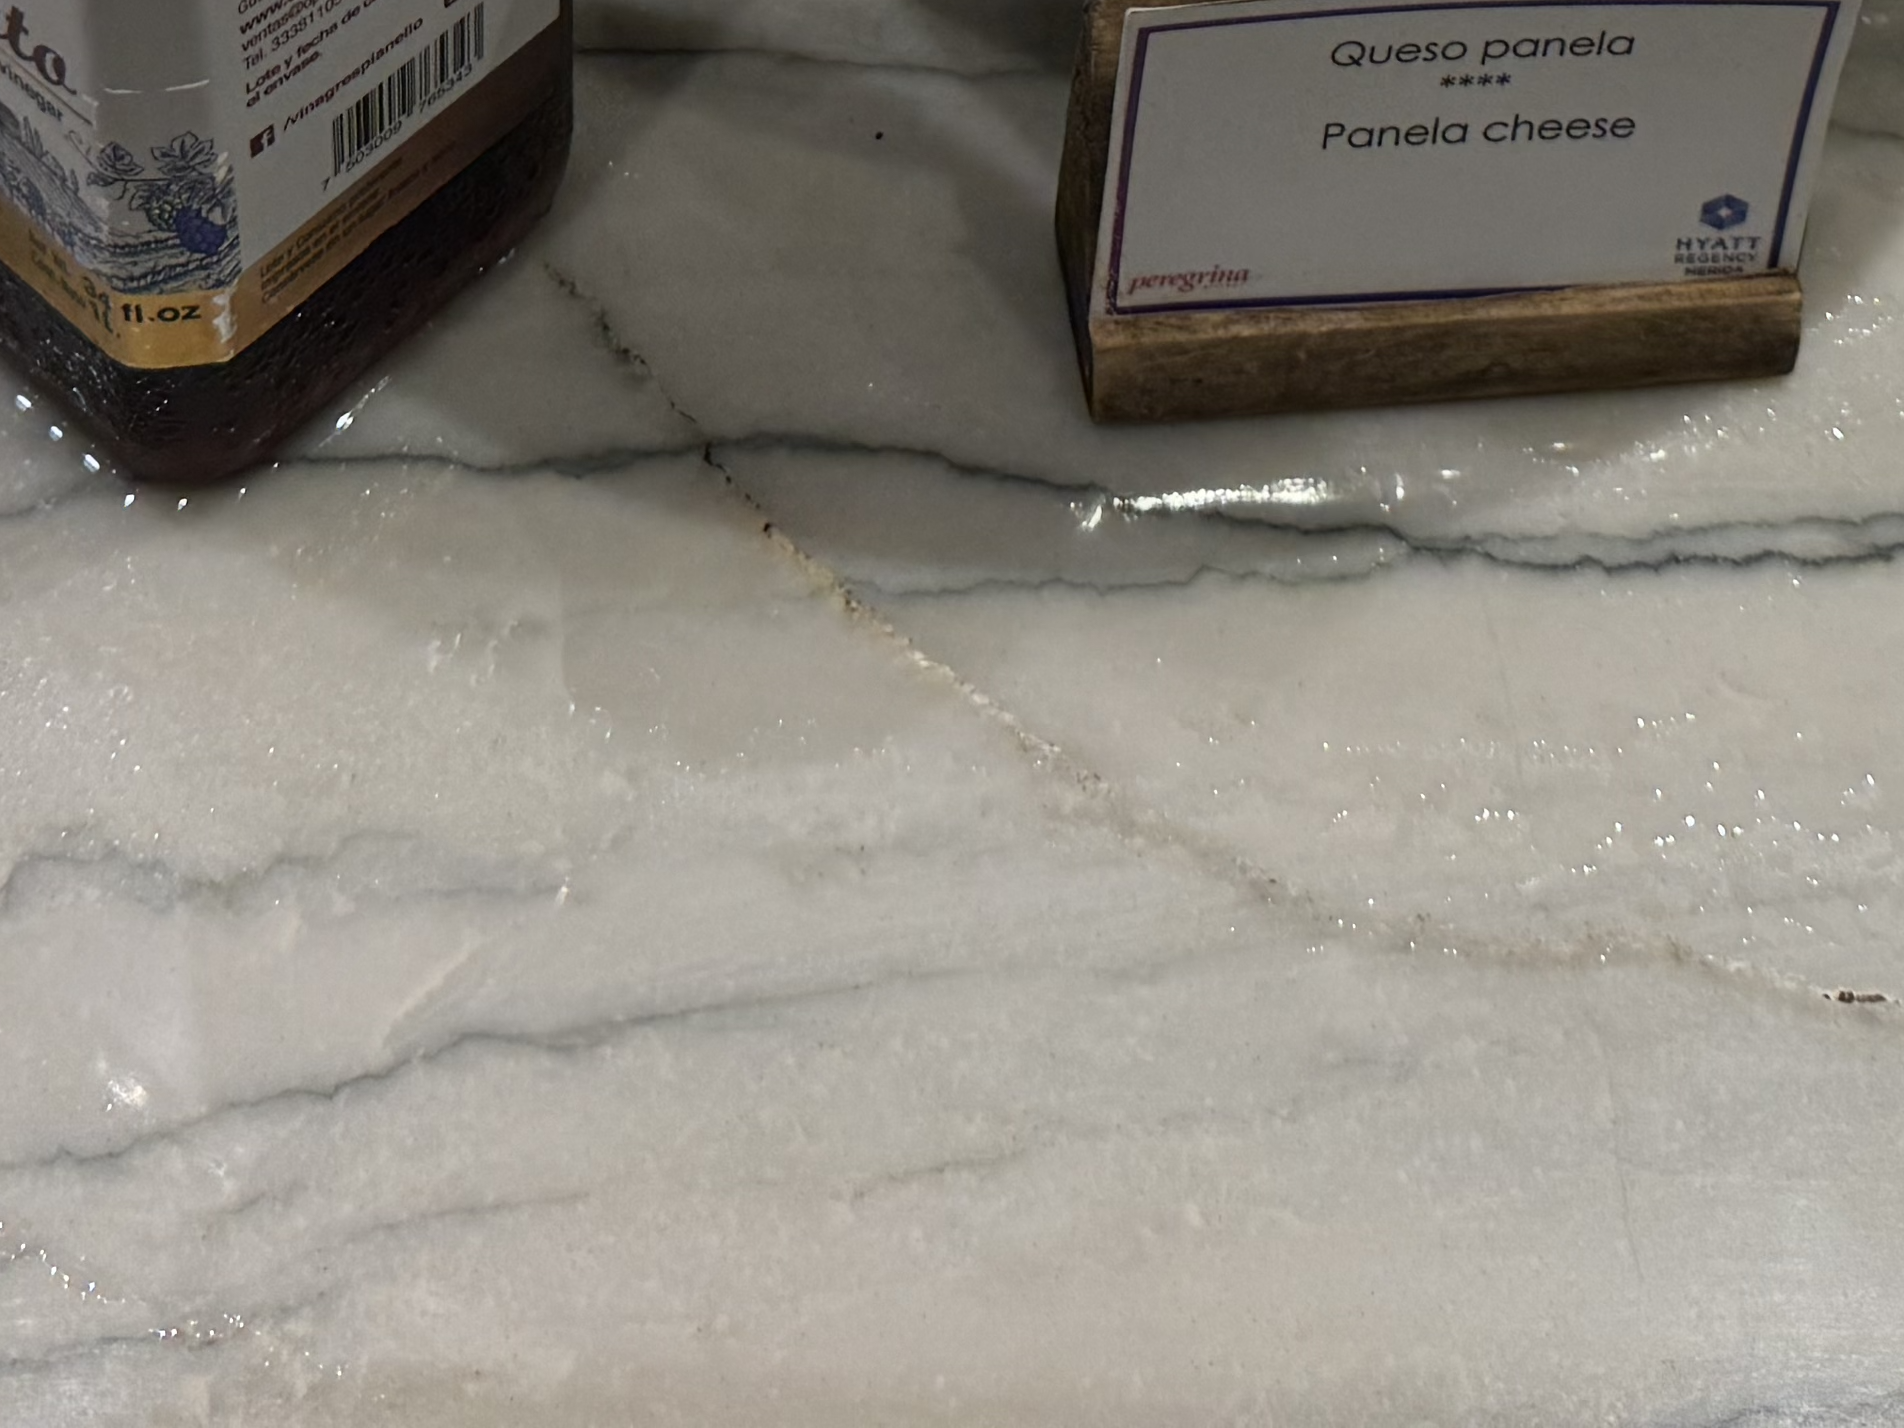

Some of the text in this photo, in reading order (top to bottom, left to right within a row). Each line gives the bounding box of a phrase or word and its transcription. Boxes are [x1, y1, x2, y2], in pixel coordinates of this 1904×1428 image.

[245, 64, 282, 95] Lote
[283, 55, 293, 70] y
[296, 22, 338, 59] fecha
[341, 5, 361, 25] de
[1331, 30, 1635, 67] Queso panela
[1322, 113, 1636, 150] Panela cheese
[1676, 235, 1762, 252] HYATT
[1127, 265, 1249, 296] peregrina
